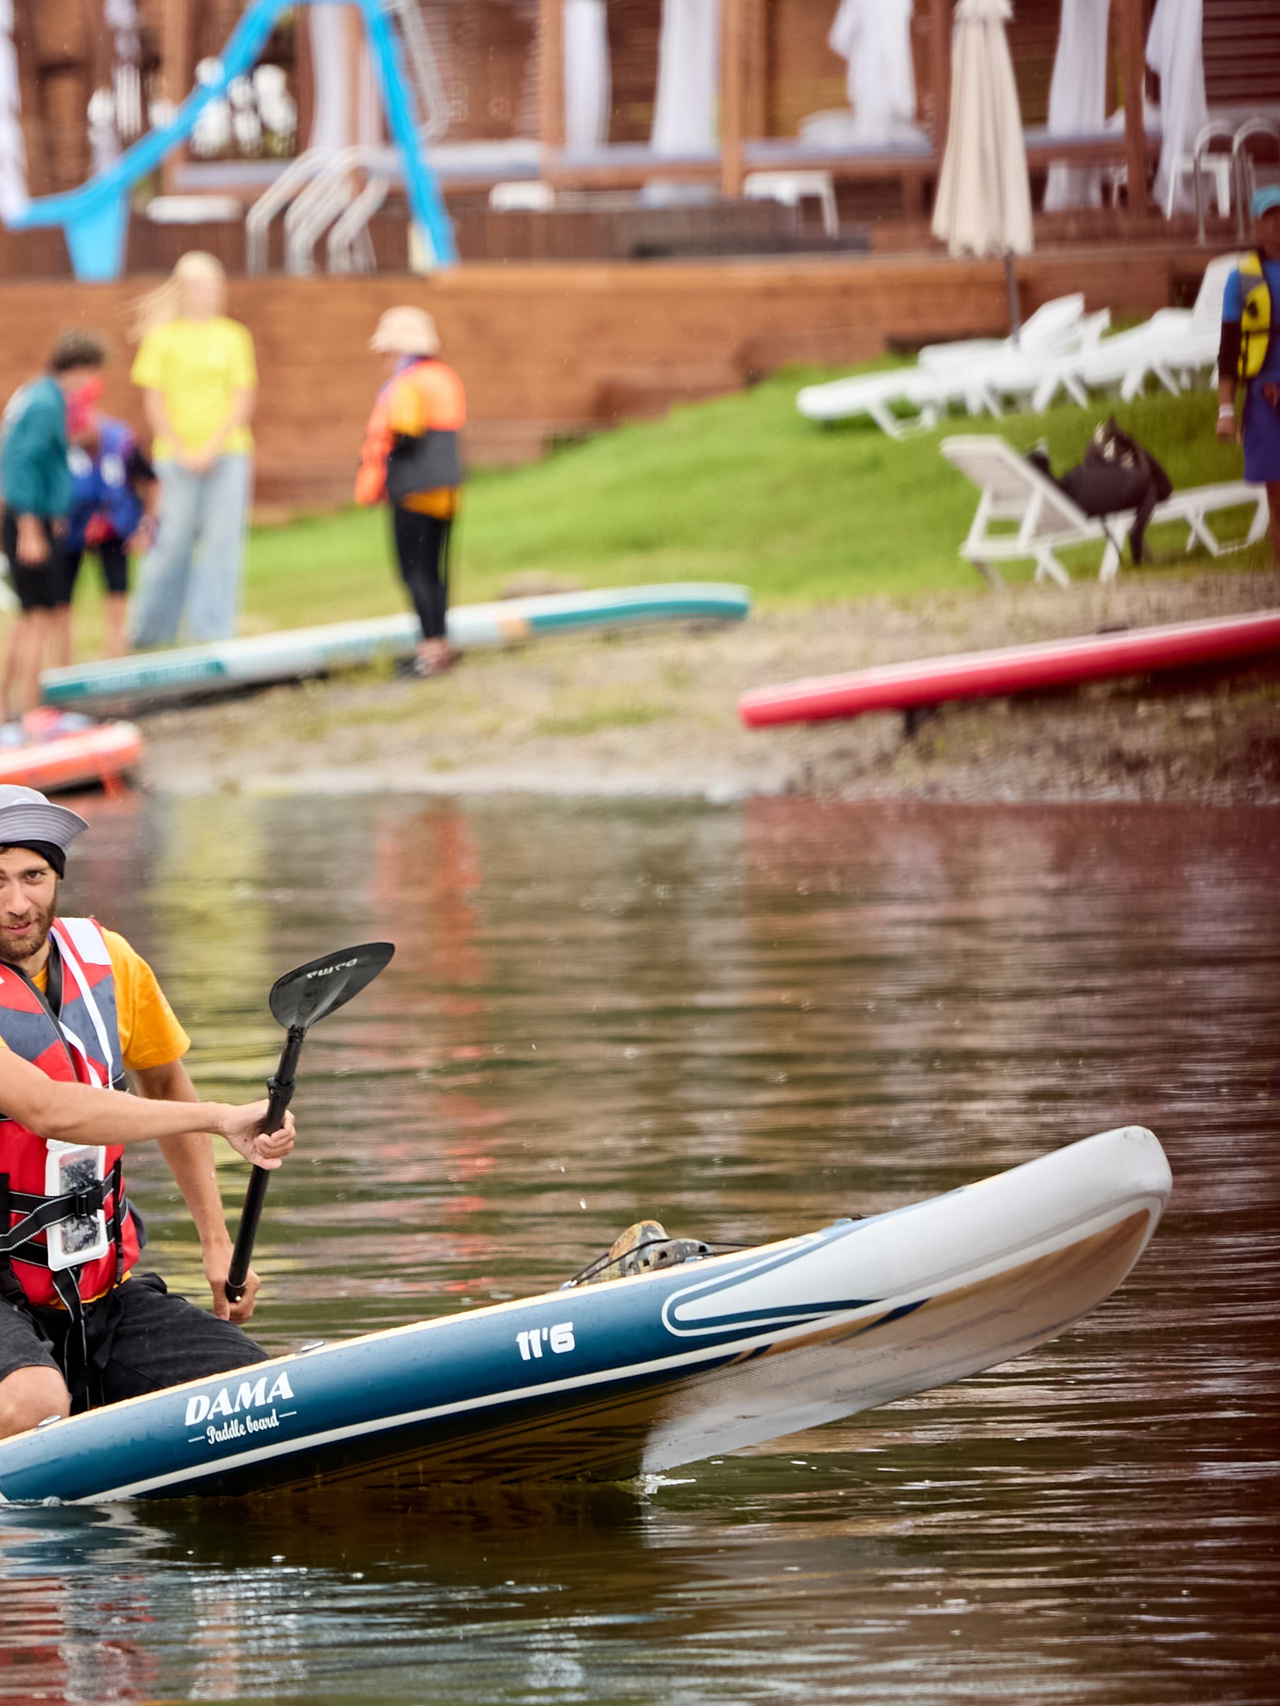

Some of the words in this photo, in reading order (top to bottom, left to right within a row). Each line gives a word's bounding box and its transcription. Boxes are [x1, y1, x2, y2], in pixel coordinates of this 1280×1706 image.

[516, 1321, 576, 1361] 11'6
[185, 1371, 294, 1426] DAMA
[206, 1418, 246, 1445] Paddle
[246, 1408, 279, 1434] board
